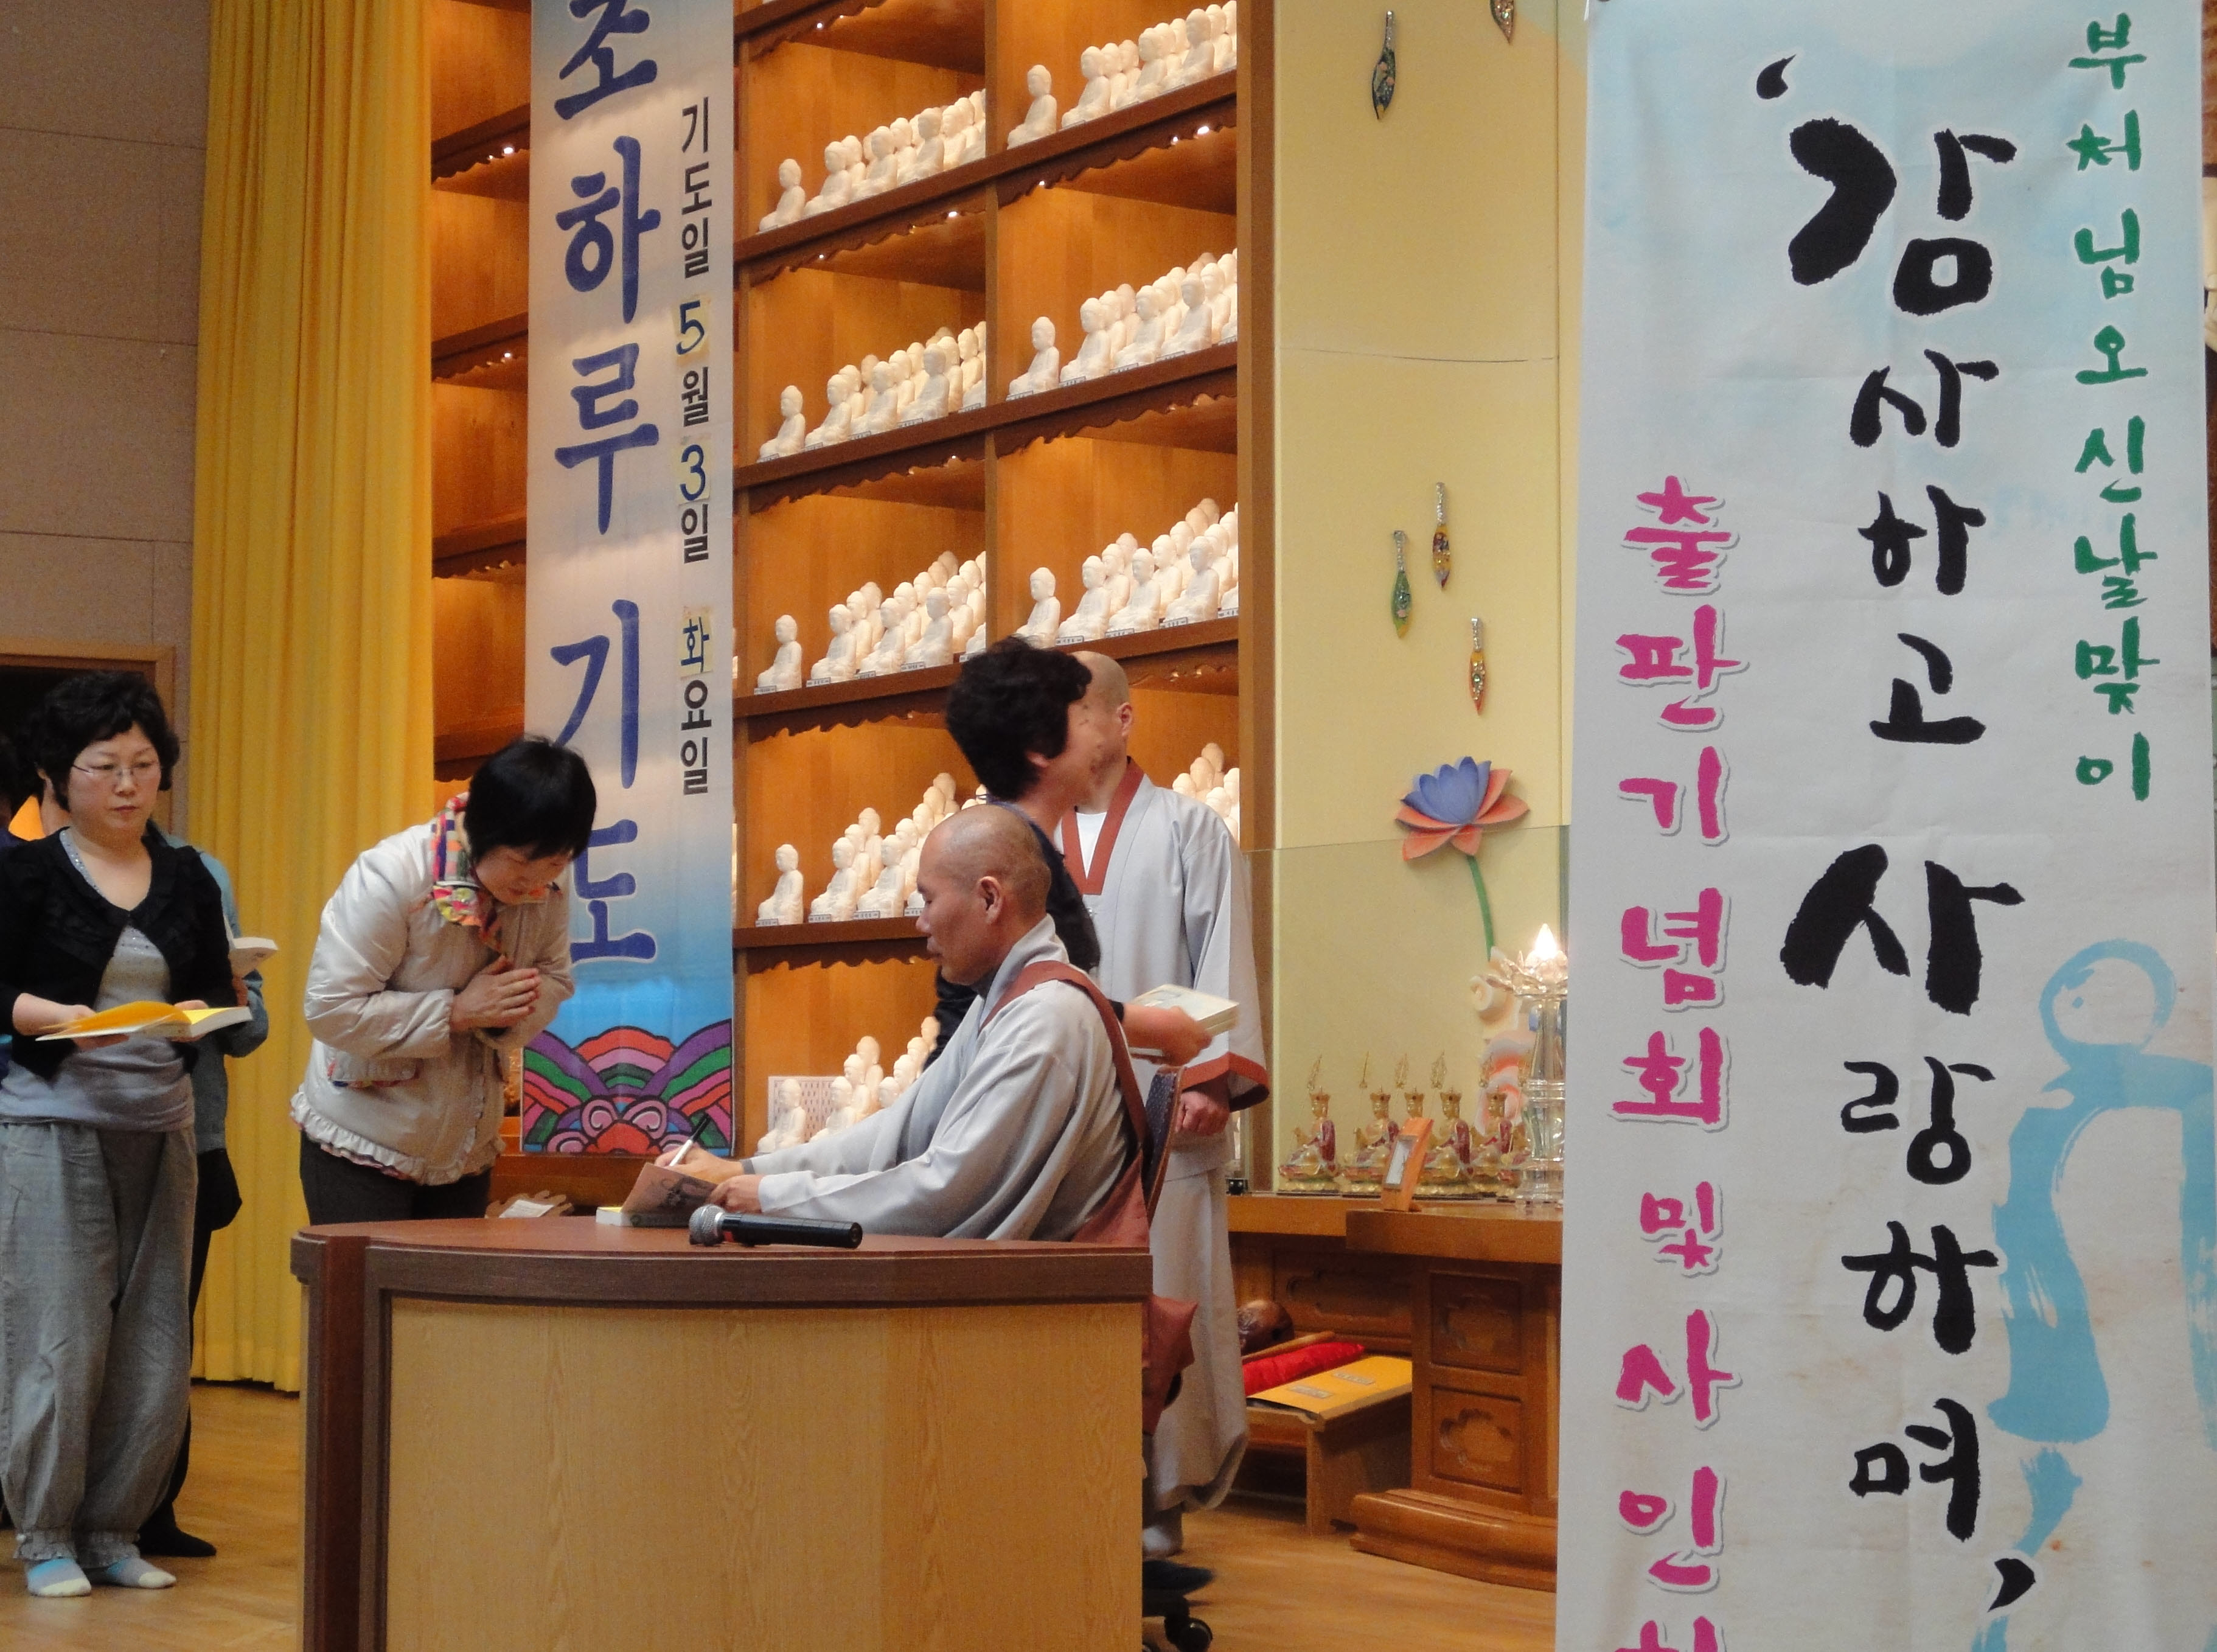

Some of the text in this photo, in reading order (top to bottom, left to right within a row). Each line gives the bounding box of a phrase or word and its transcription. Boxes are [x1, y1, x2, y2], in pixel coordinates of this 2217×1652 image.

[681, 96, 712, 279] 기도일
[680, 616, 712, 795] 화요일
[1640, 1180, 1718, 1273] 및
[1615, 1308, 1739, 1652] 사인
